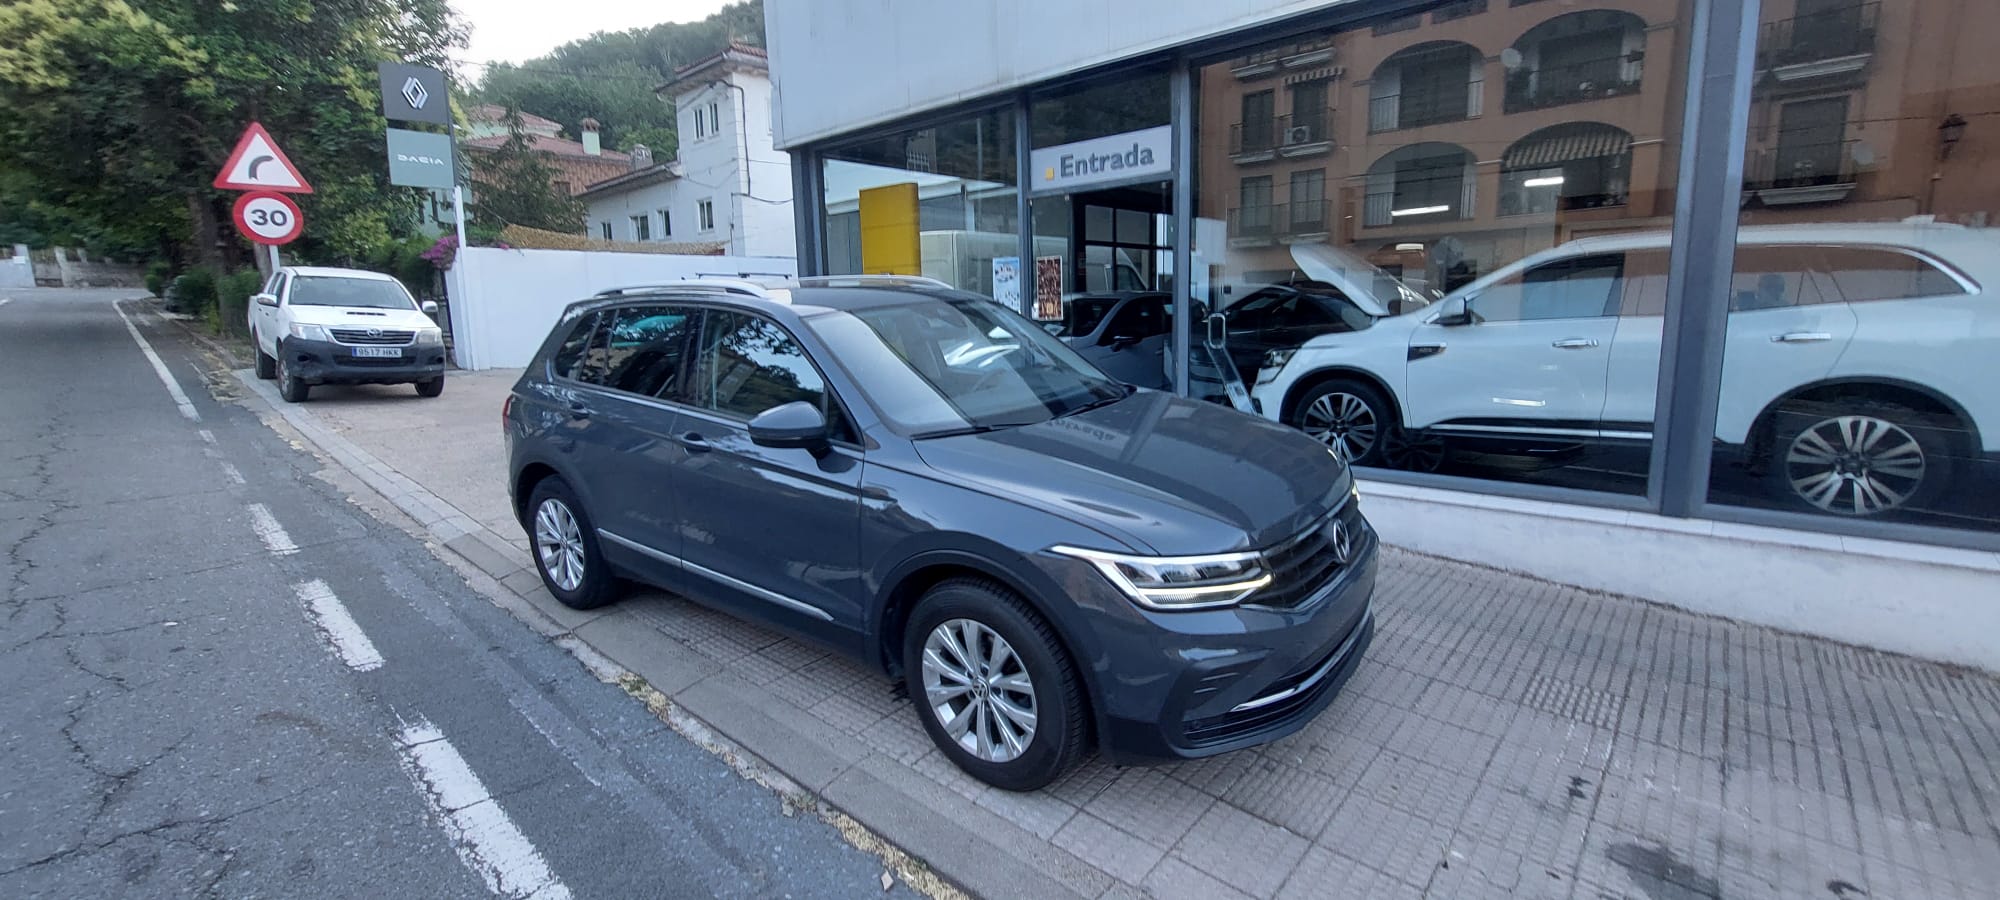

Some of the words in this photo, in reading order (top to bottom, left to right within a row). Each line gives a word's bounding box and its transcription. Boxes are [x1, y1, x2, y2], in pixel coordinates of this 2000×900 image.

[397, 153, 445, 166] DACIA
[1060, 142, 1154, 178] Entrada
[251, 209, 287, 226] 30
